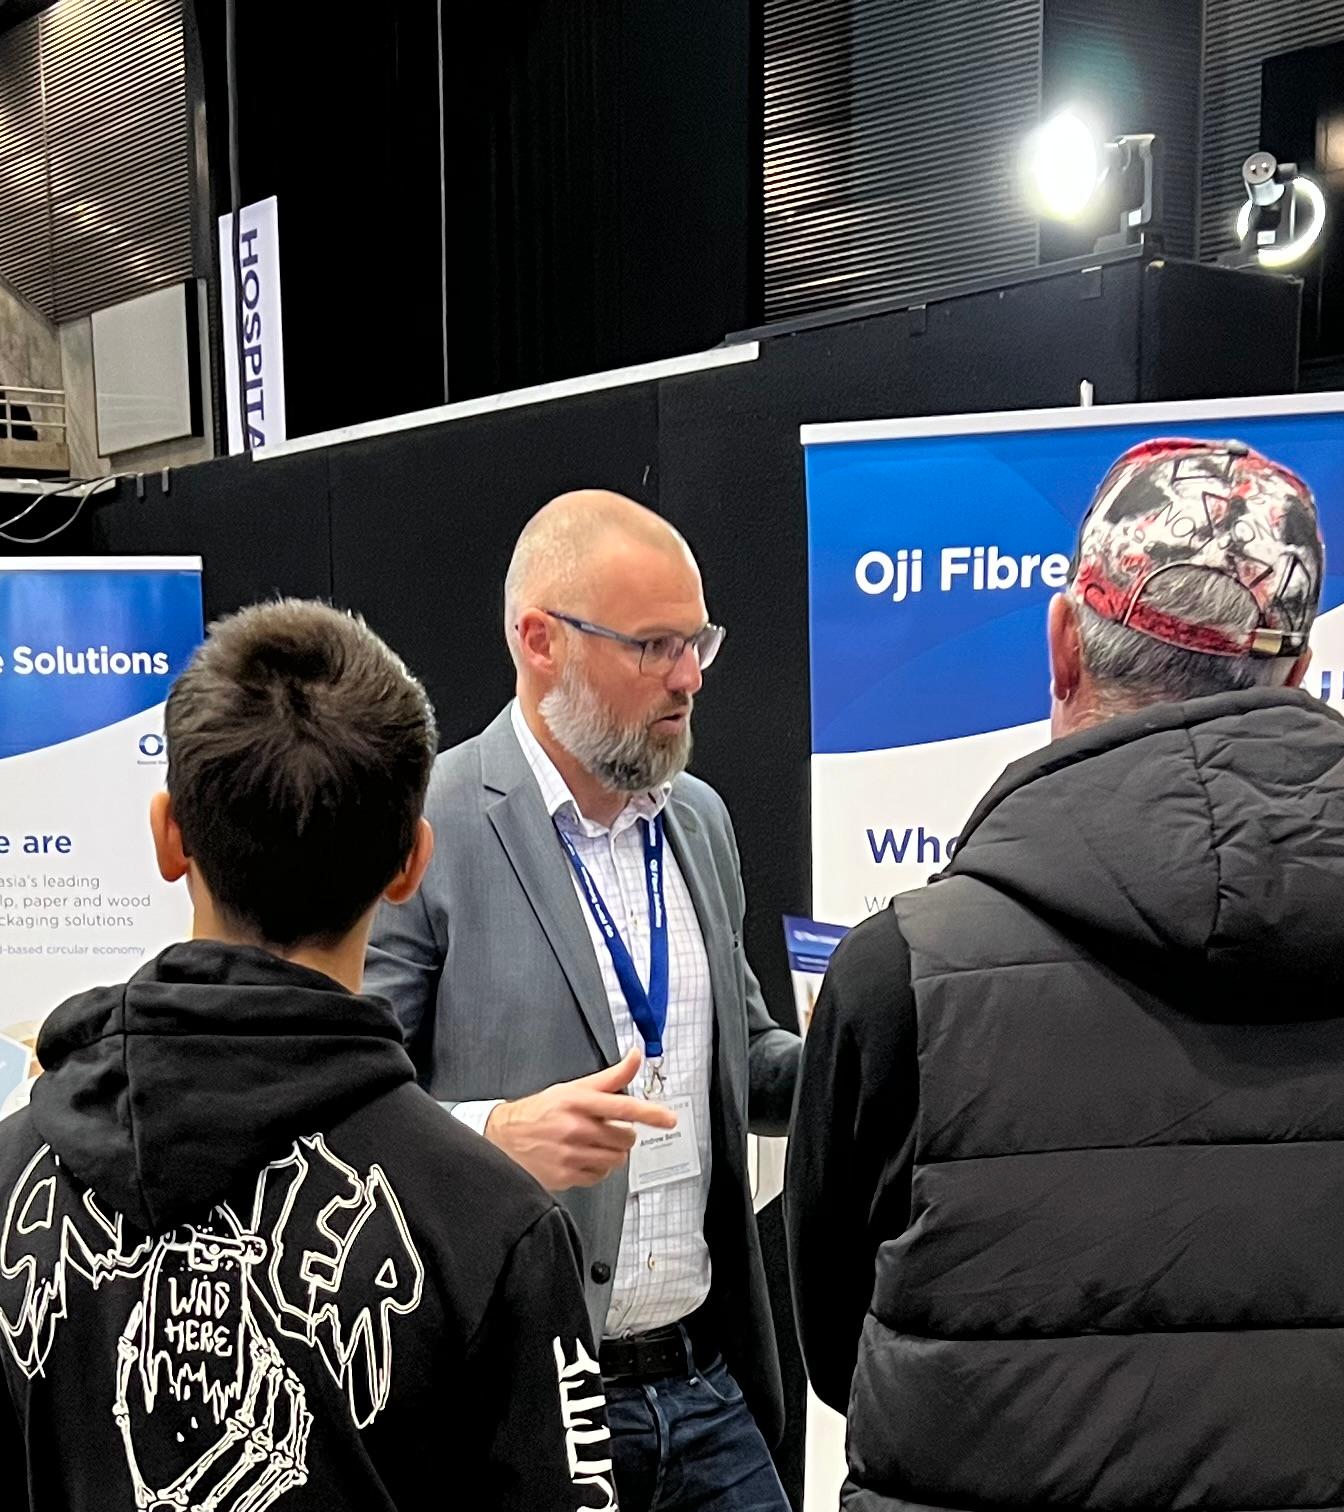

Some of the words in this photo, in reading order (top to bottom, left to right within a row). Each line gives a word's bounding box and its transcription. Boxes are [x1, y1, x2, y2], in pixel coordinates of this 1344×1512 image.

[855, 548, 923, 602] Oji
[941, 545, 1070, 591] Fibre
[13, 645, 170, 676] Solutions
[23, 835, 72, 854] are
[43, 874, 100, 890] leading
[23, 896, 68, 910] paper
[73, 894, 102, 908] and
[107, 894, 151, 908] wood
[64, 913, 134, 927] solutions
[46, 944, 88, 955] circular
[92, 946, 146, 957] economy
[167, 1274, 231, 1319] WAS
[164, 1318, 233, 1357] HERE
